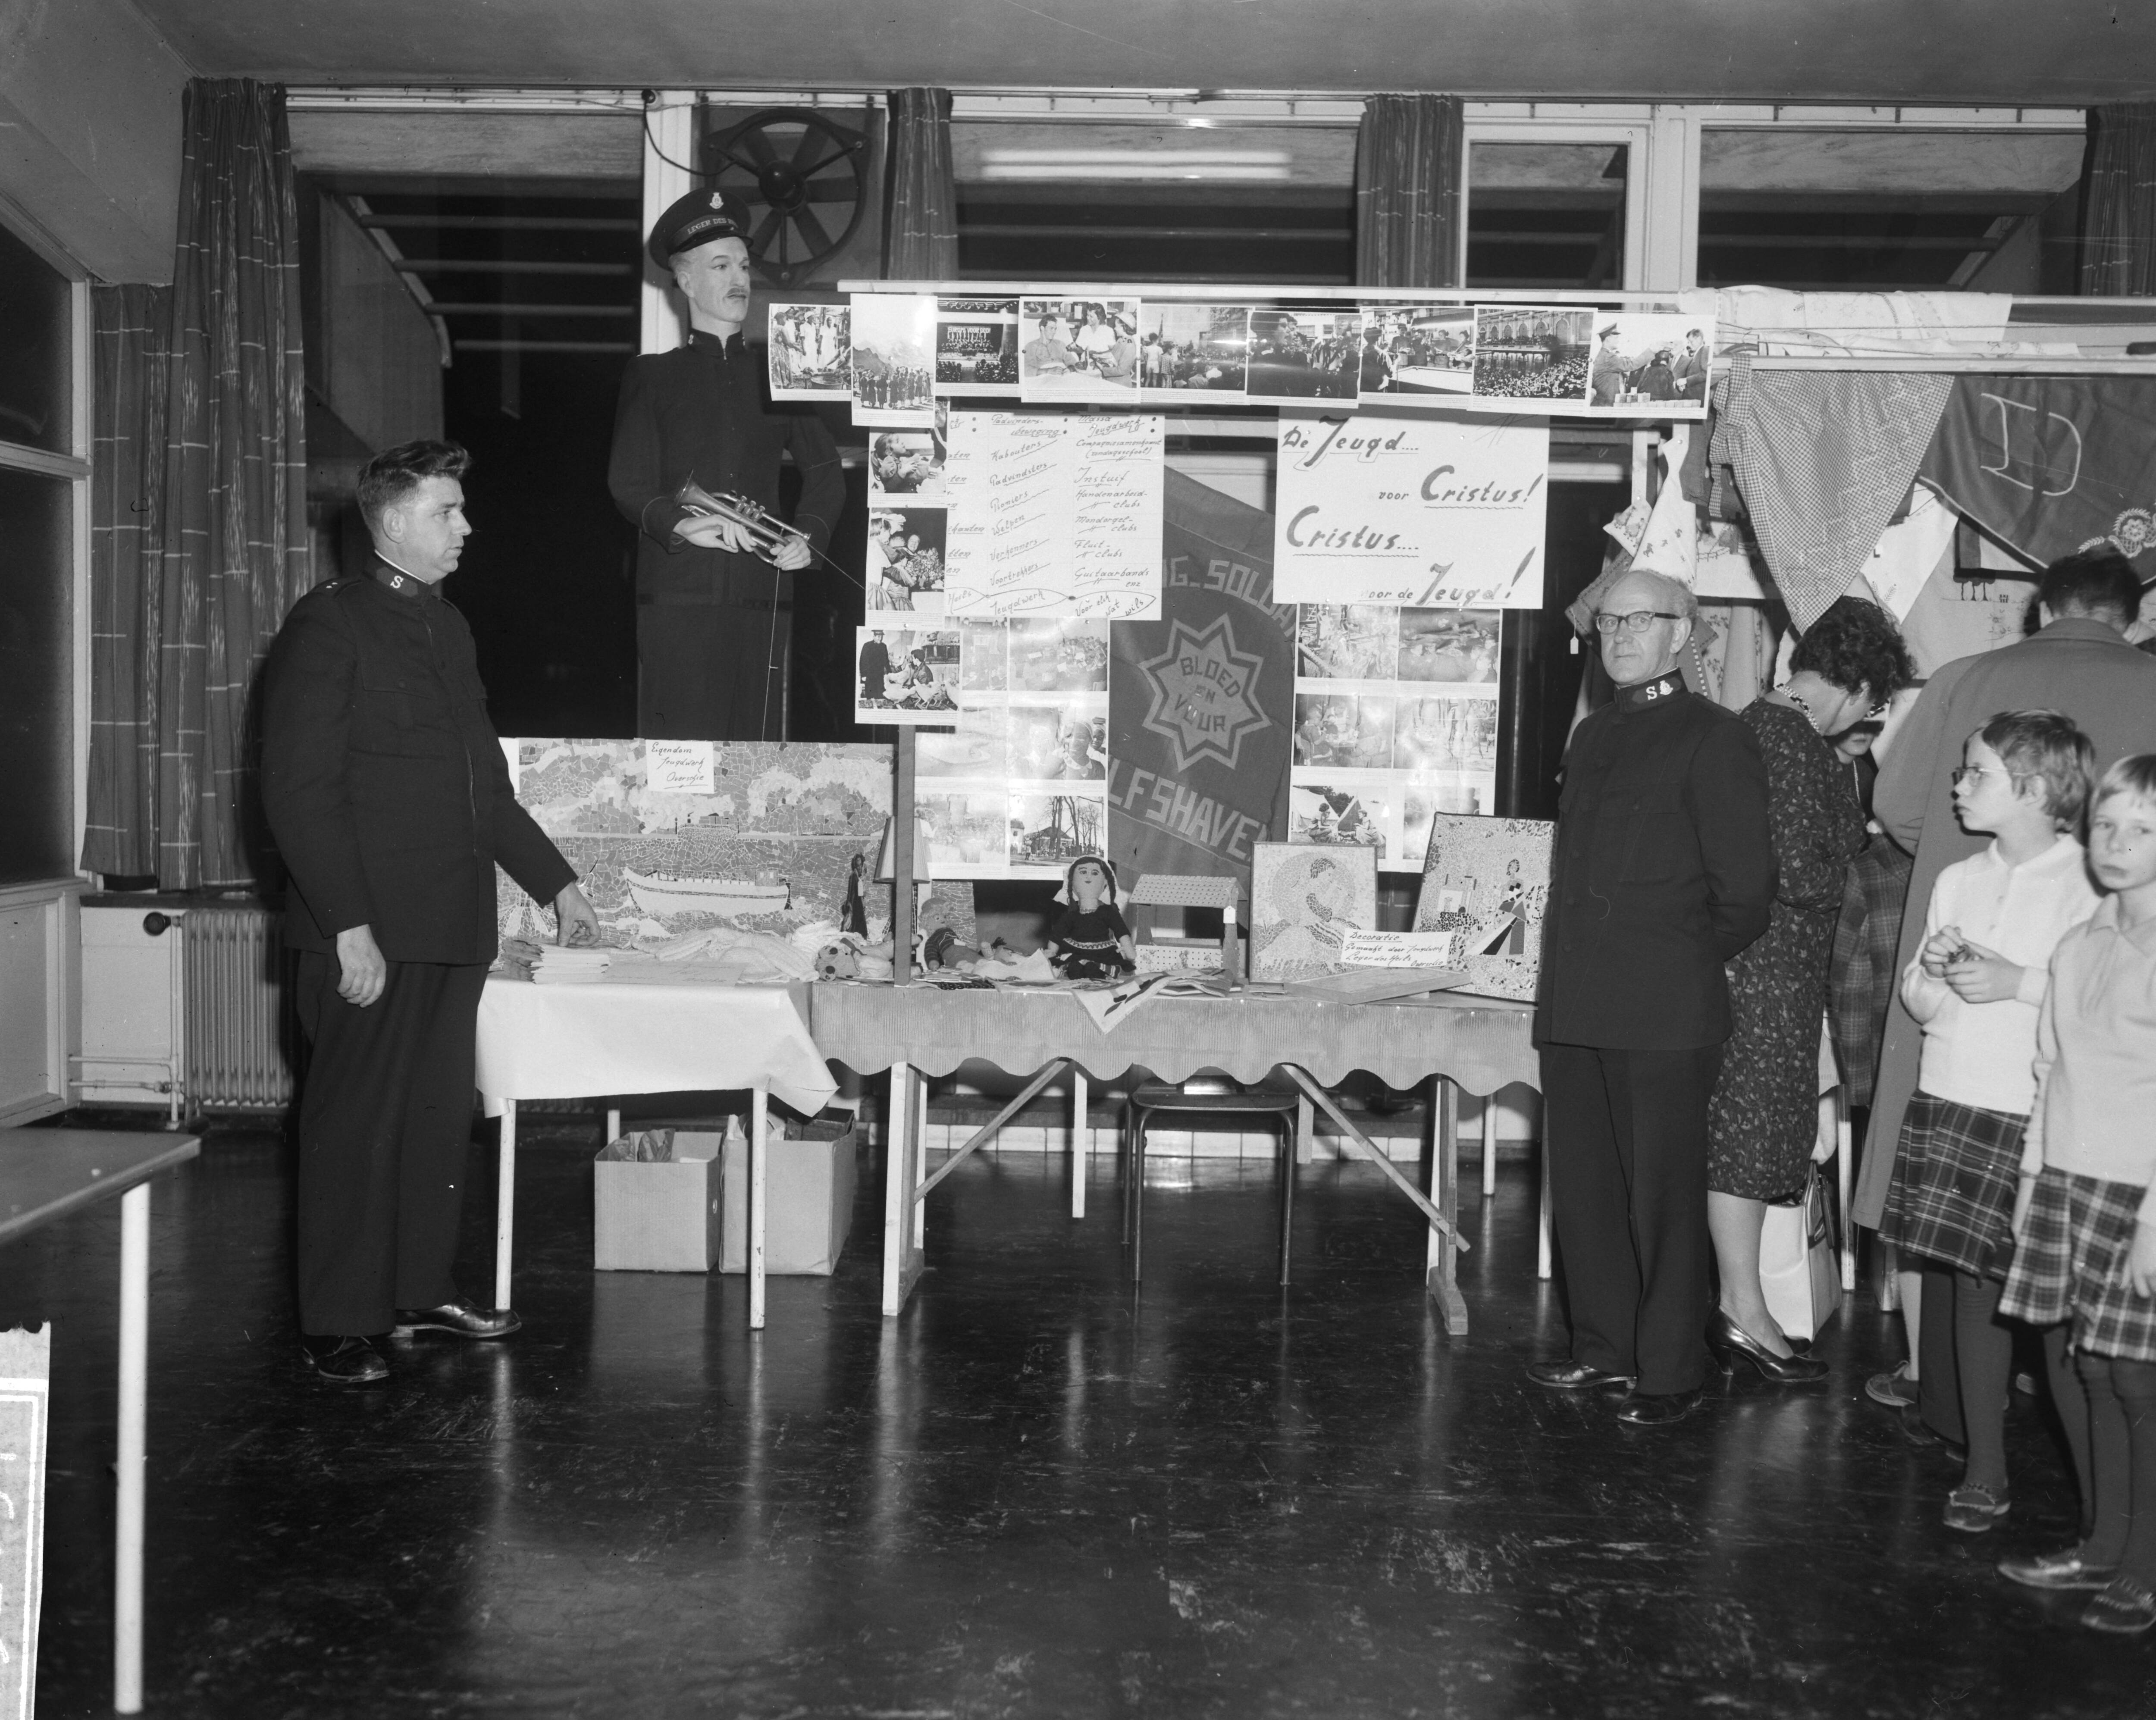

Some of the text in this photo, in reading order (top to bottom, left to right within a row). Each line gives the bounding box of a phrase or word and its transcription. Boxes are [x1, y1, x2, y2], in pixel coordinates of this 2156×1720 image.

[687, 219, 711, 235] LEGER
[1282, 426, 1309, 448] De
[991, 441, 1041, 461] Kabouters
[990, 464, 1047, 486] Padvindsters
[1378, 464, 1544, 503] voor Cristus!
[1113, 500, 1141, 508] clubs
[991, 515, 1025, 536] Welpen
[990, 539, 1037, 561] Verkenners
[1095, 549, 1123, 558] clubs
[390, 575, 404, 589] S
[990, 563, 1038, 586] Voortrekkers
[1398, 588, 1413, 599] de
[1180, 656, 1241, 698] BLOED
[1194, 684, 1216, 704] EN
[1645, 686, 1658, 700] S
[1174, 693, 1225, 732] VUUR
[651, 741, 692, 756] Eigendom
[657, 757, 705, 774] Jeugdwerk
[1108, 755, 1267, 862] LFSHAVE
[1349, 931, 1400, 941] Decoratie
[1345, 951, 1373, 962] Leger
[1387, 954, 1411, 966] Heils
